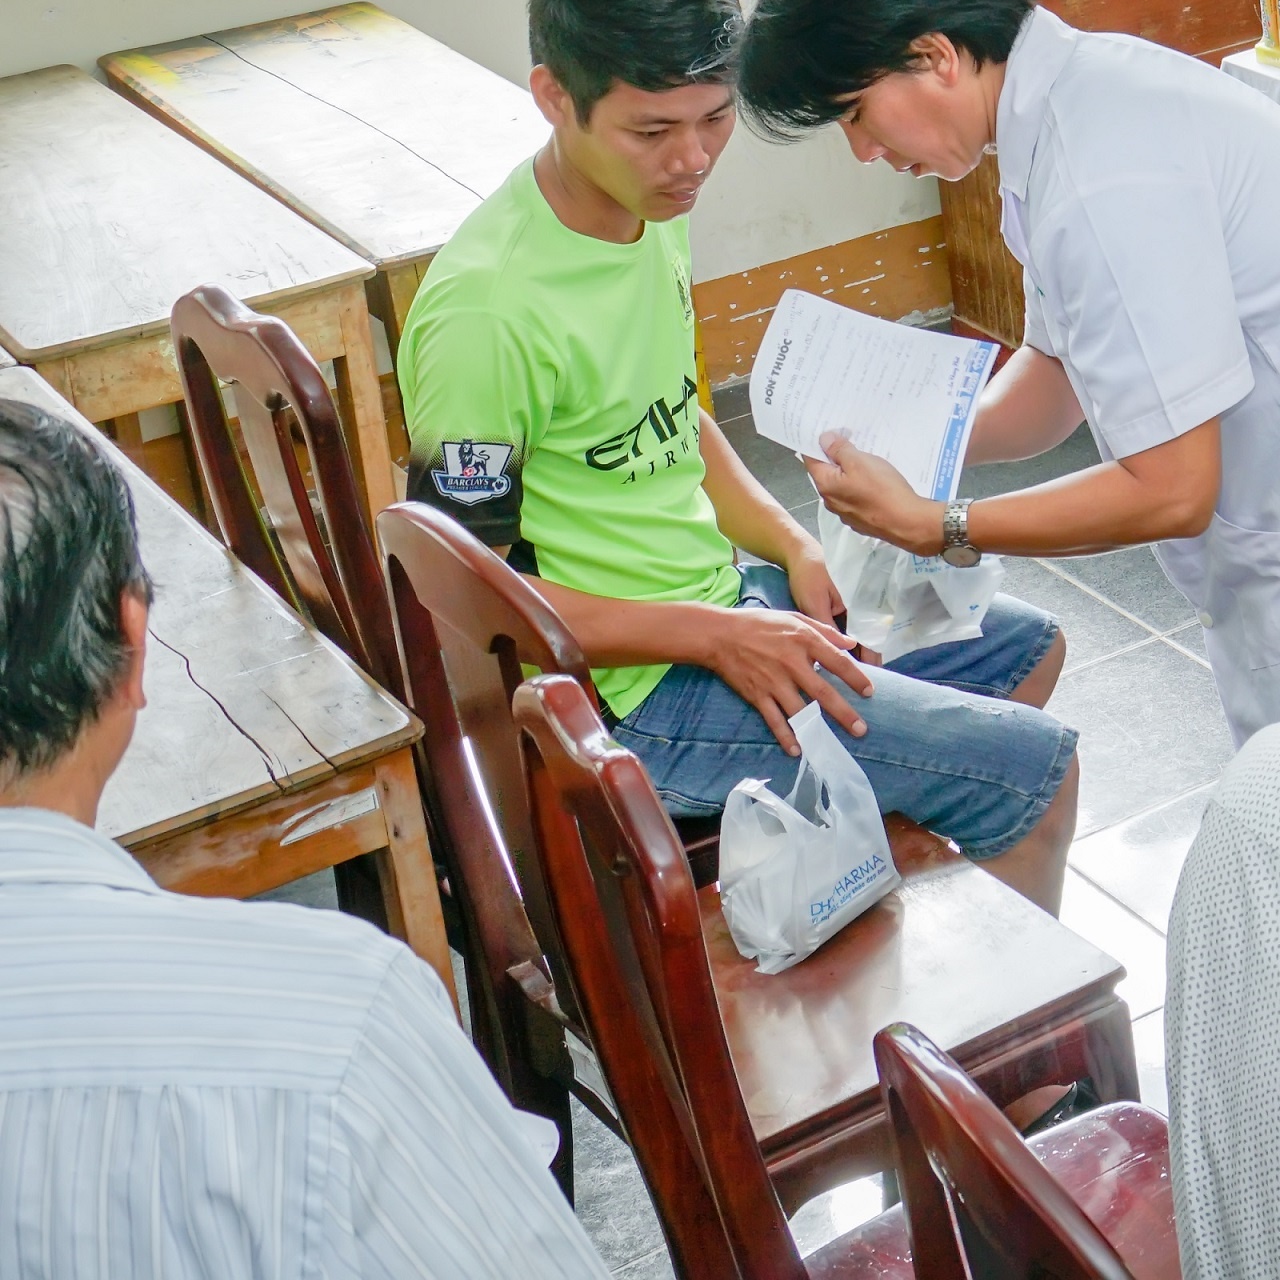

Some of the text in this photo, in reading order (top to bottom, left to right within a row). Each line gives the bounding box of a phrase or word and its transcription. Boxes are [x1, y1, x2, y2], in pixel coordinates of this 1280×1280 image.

[772, 337, 792, 379] THUỐC
[447, 477, 489, 487] BARCLAYS
[810, 854, 884, 917] DH HARMA
